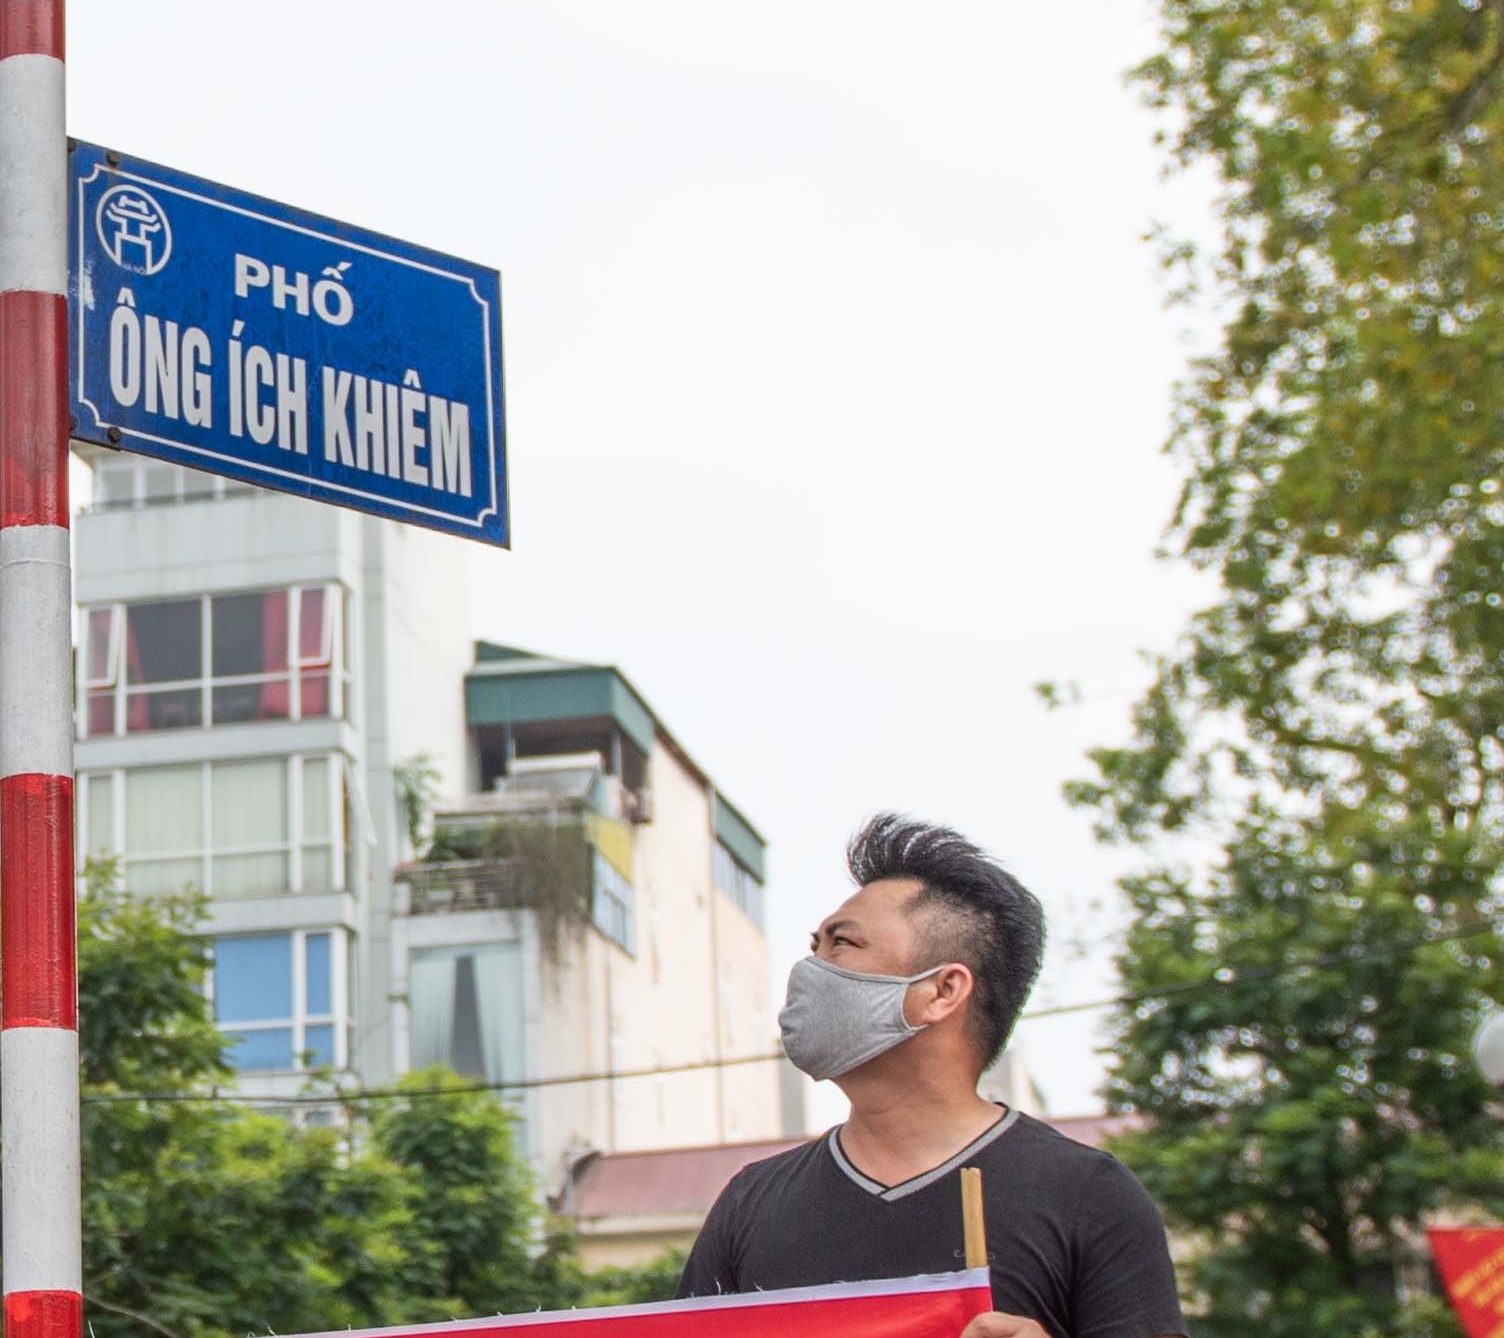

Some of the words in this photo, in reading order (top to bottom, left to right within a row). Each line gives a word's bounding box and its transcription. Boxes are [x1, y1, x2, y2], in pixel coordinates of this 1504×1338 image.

[233, 254, 353, 336] PHỐ
[110, 288, 211, 428] ÔNG
[230, 320, 307, 454] ÍCH
[324, 367, 471, 497] KHIÊM
